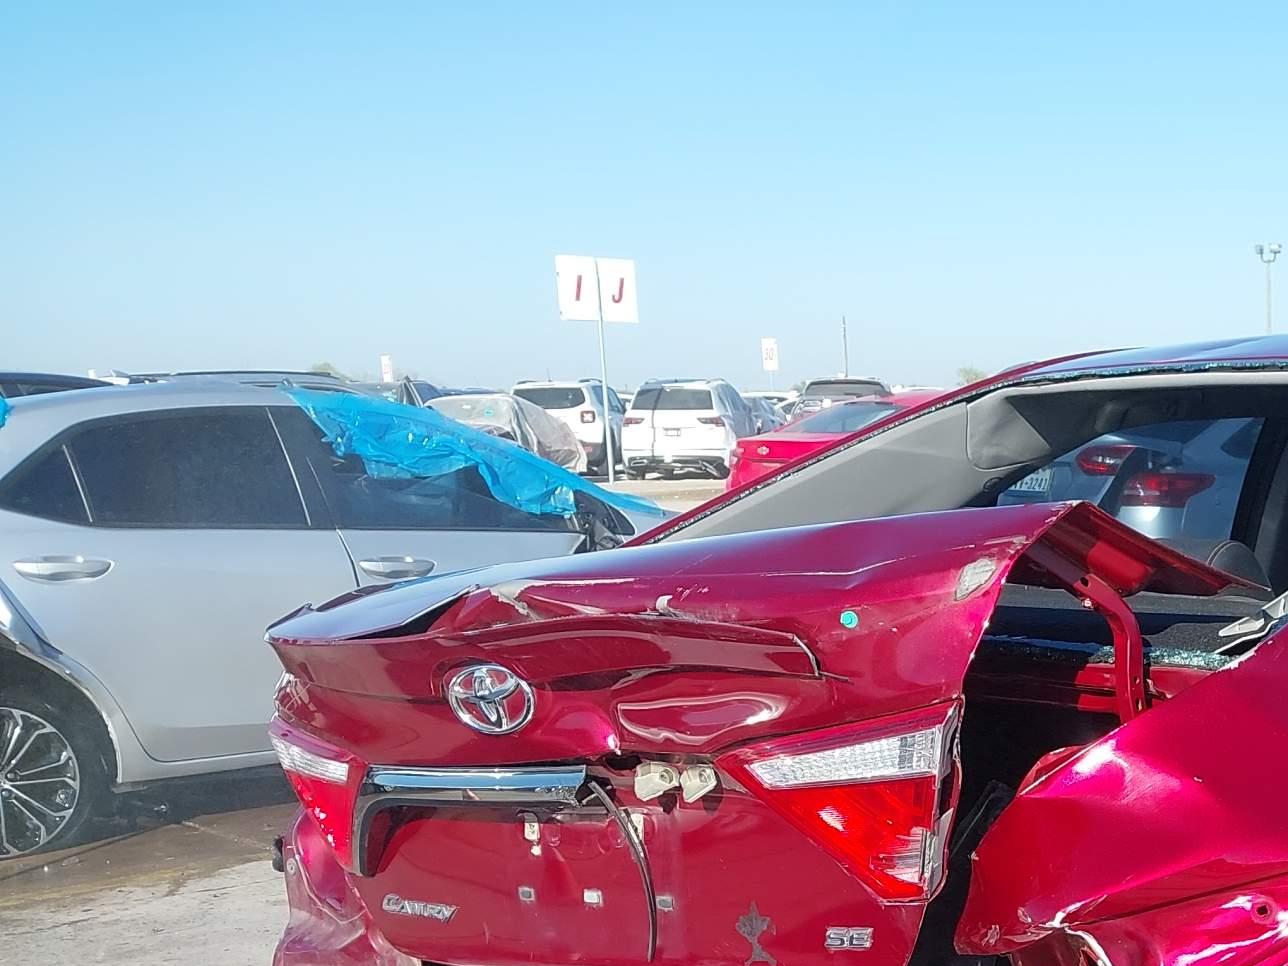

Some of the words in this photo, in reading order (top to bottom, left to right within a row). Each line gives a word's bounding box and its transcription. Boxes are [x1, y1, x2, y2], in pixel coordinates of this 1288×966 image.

[611, 277, 625, 304] J
[382, 893, 460, 924] CAMRY
[824, 926, 874, 951] SE
